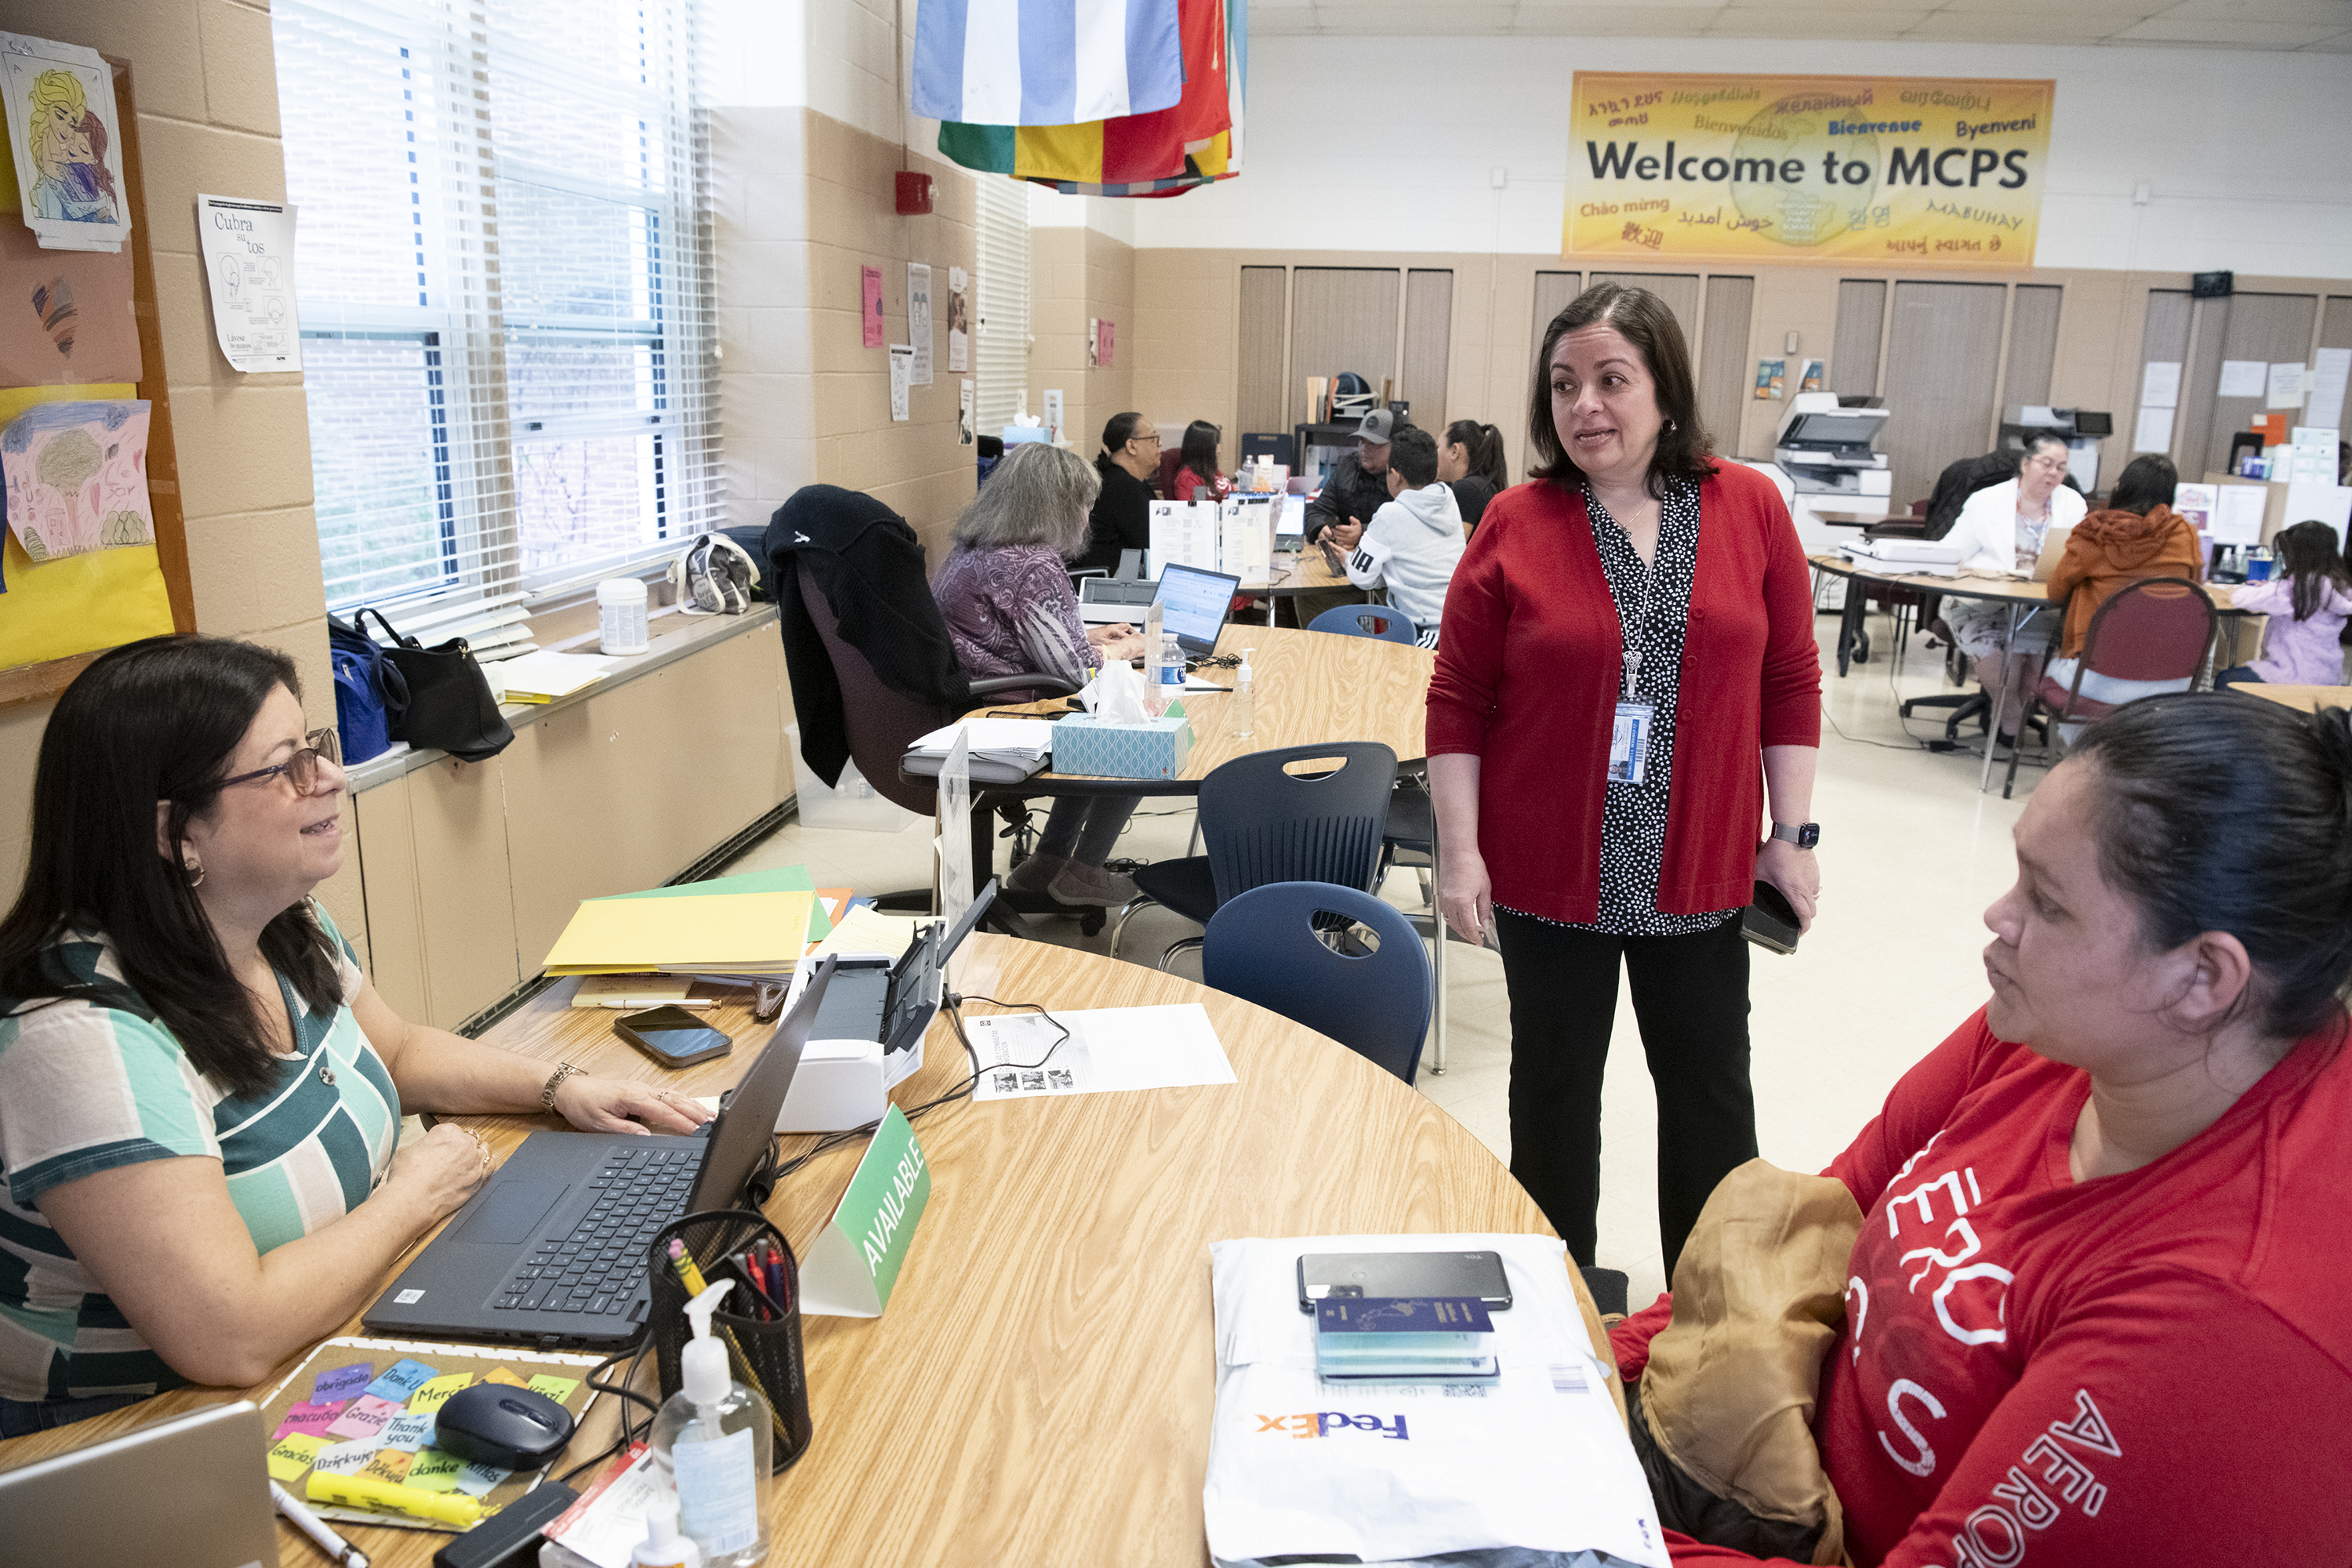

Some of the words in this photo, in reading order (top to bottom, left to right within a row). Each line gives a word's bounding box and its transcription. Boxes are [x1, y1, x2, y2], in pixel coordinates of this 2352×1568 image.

[1693, 114, 1789, 141] Bienvenidos
[1828, 119, 1922, 136] Bienvenue
[1956, 114, 2036, 140] Byenveni
[1587, 141, 1806, 184] Welcome
[1823, 151, 1871, 186] to
[1887, 147, 2029, 189] MCPS
[215, 212, 253, 231] Cubra
[1849, 204, 1890, 231] 환영
[1926, 199, 2024, 230] MABUHAY
[1621, 221, 1664, 249] 歡迎
[247, 239, 265, 254] tos
[863, 1136, 924, 1277] AVAILABLE
[315, 1374, 369, 1392] obrigado
[383, 1368, 412, 1387] Dank
[408, 1379, 423, 1391] U
[417, 1384, 464, 1402] Merc
[346, 1406, 388, 1426] Grazie
[388, 1417, 428, 1434] Thank
[1254, 1411, 1410, 1440] FedEx
[383, 1433, 416, 1445] you
[272, 1445, 315, 1465] Gracias
[408, 1461, 459, 1476] danke
